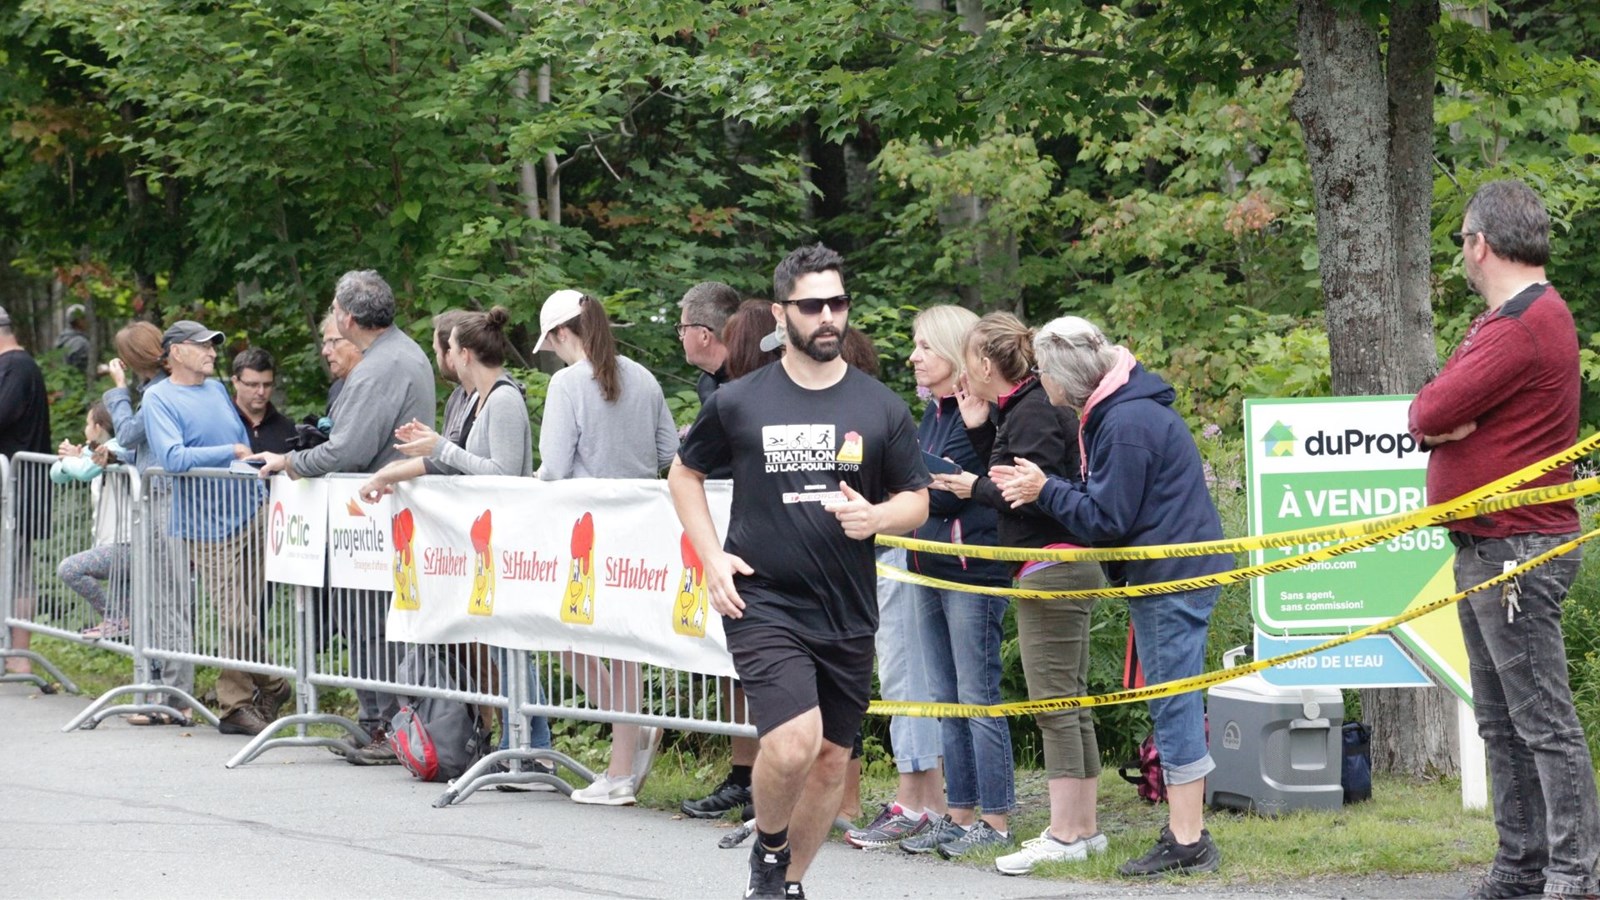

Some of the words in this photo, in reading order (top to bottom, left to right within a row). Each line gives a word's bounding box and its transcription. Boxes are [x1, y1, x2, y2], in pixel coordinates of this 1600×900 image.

[1305, 429, 1421, 458] duProp
[764, 450, 836, 463] TRIATHLON
[765, 464, 779, 473] DU
[780, 463, 836, 472] LAC-POULIN
[1278, 484, 1303, 518] À
[1304, 486, 1428, 517] VENDR
[287, 514, 310, 547] iClic
[333, 516, 384, 558] projektile
[1280, 591, 1304, 601] Sans
[1306, 591, 1335, 602] agent,
[1280, 603, 1303, 611] sans
[1304, 600, 1364, 611] commission!
[1276, 656, 1317, 670] BORD
[1321, 656, 1342, 668] DE
[1344, 655, 1383, 668] L'EAU
